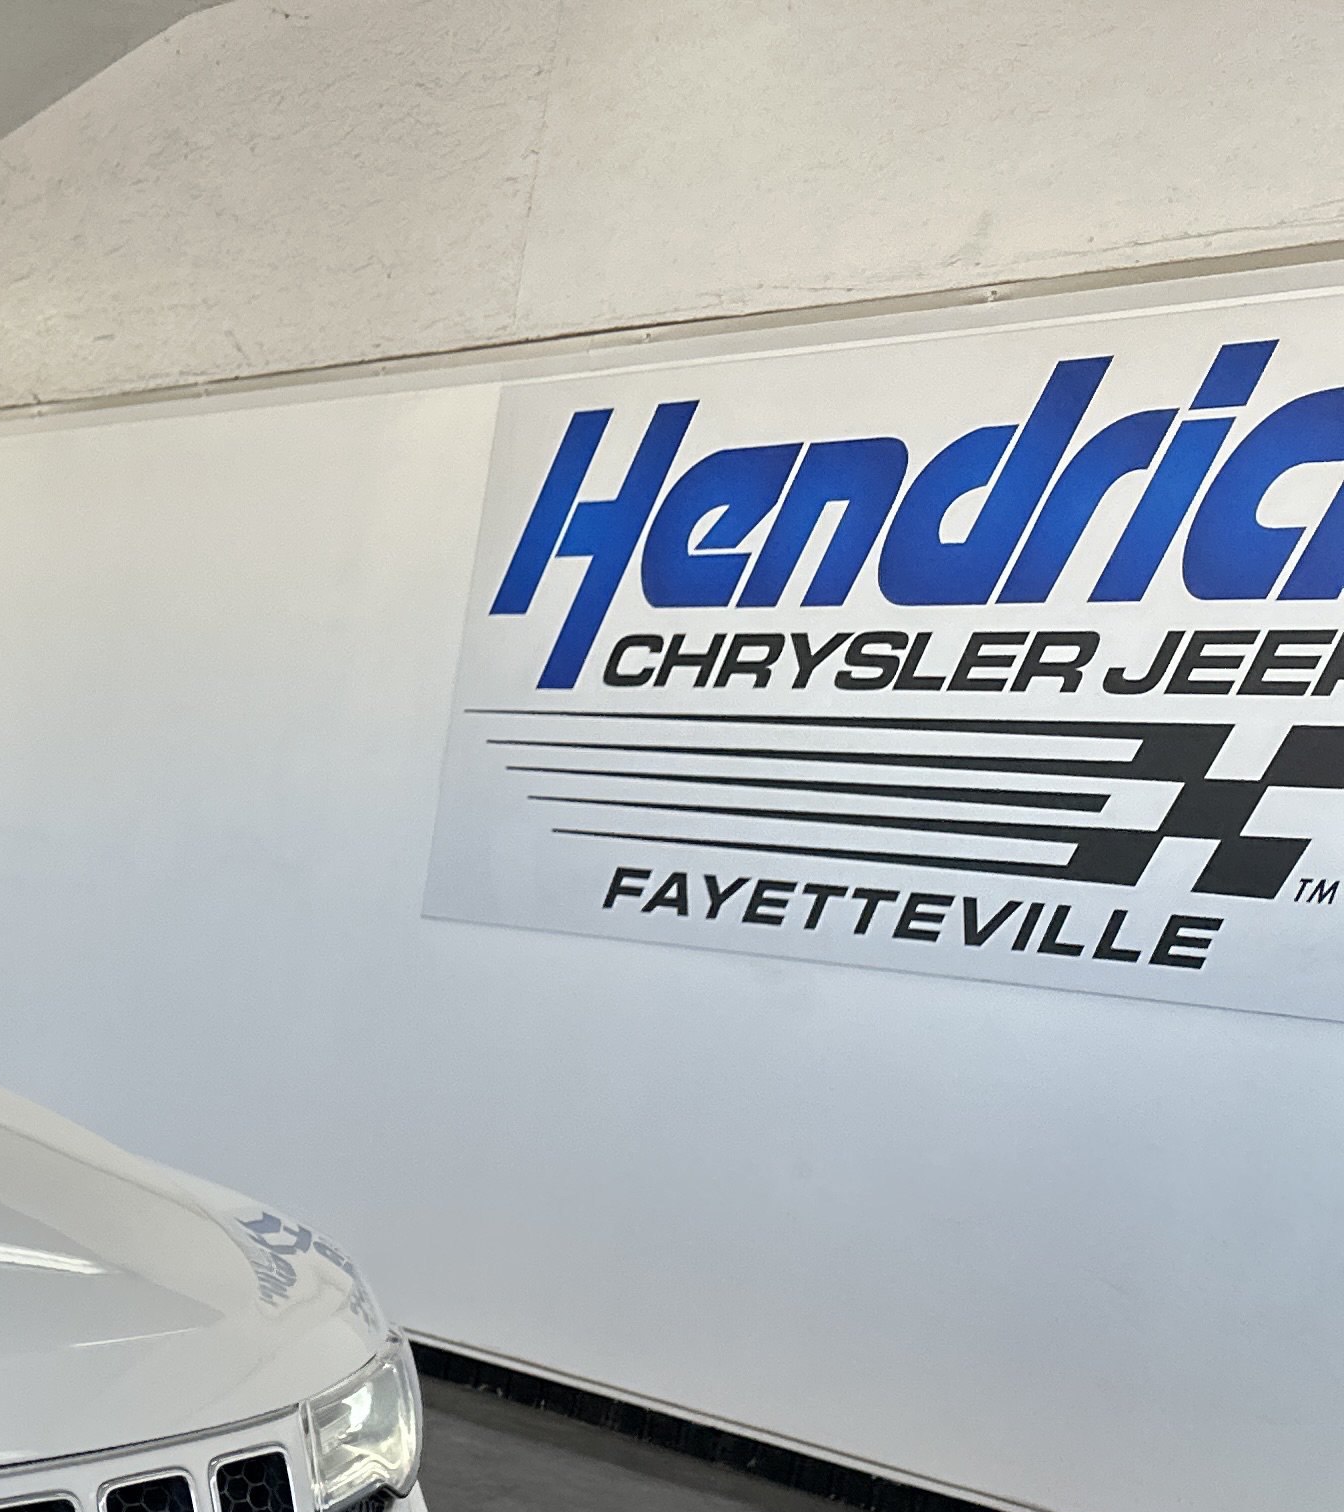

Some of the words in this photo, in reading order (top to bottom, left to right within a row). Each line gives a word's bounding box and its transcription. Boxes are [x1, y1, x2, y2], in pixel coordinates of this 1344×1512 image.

[602, 629, 1100, 694] CHRYSLER
[602, 867, 1225, 971] FAYETTEVILLE
[1293, 877, 1341, 905] TM
